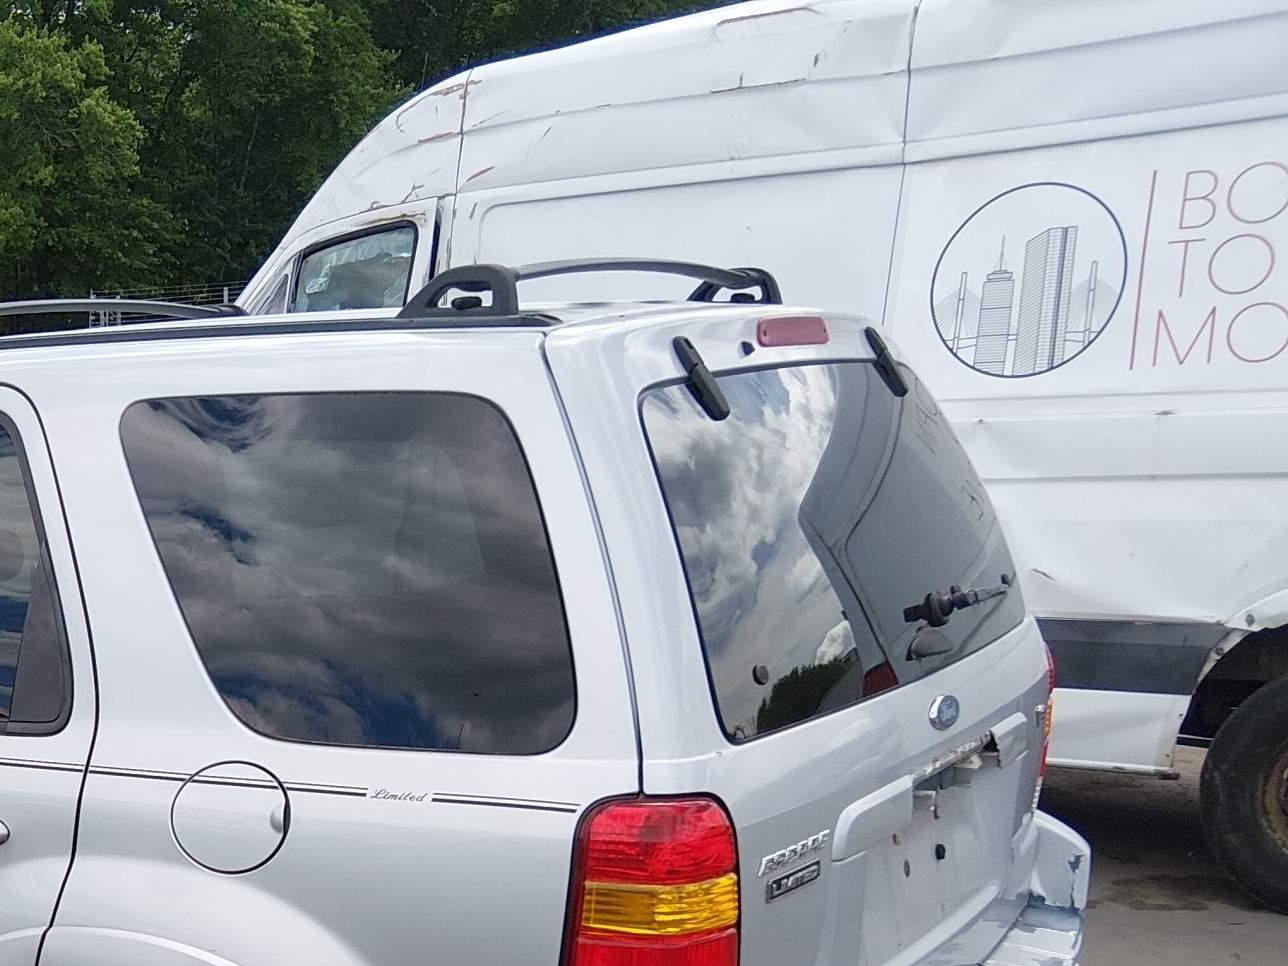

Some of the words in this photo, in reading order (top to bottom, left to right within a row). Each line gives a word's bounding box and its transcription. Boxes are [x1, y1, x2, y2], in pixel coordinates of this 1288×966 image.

[1178, 161, 1288, 230] BO
[1168, 233, 1275, 298] TO
[1152, 302, 1288, 368] MO
[370, 788, 428, 803] Limited
